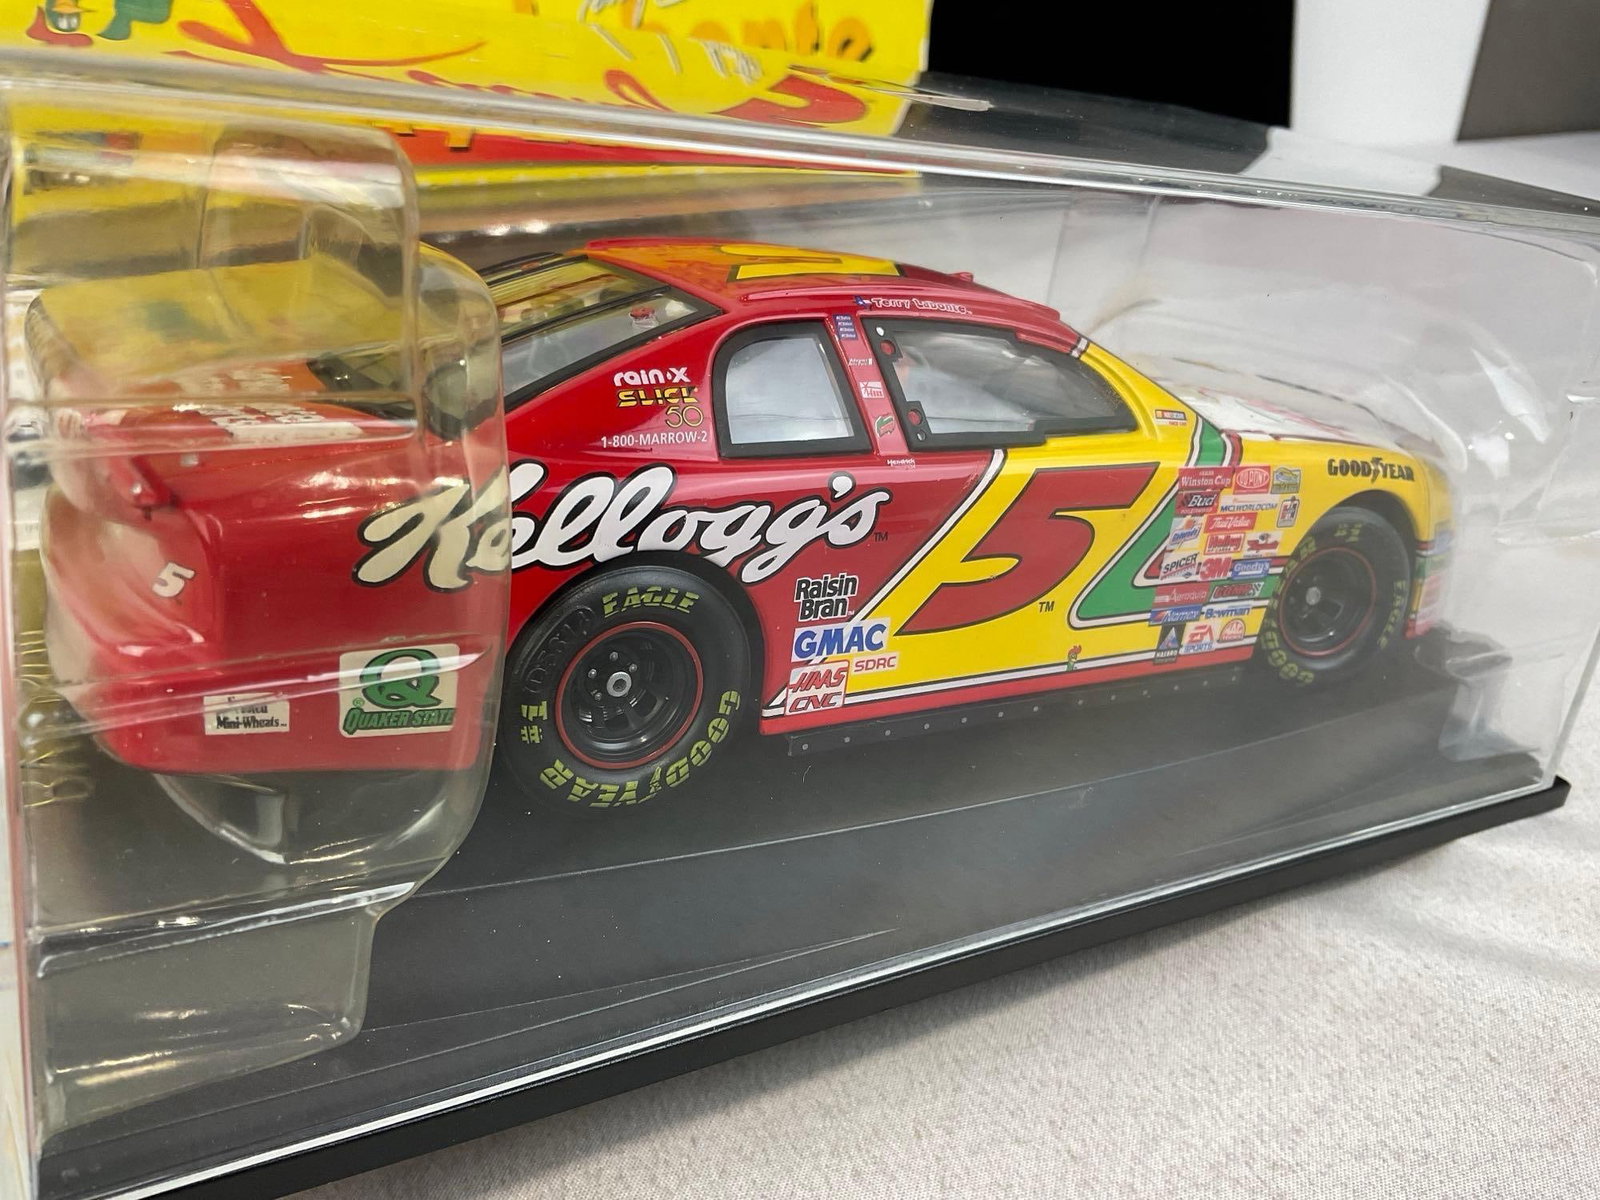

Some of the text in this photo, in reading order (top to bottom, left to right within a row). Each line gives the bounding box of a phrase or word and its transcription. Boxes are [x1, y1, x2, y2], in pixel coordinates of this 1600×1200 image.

[871, 297, 911, 309] Terry
[665, 405, 704, 428] 50
[600, 430, 708, 448] 1-800-MARROW-2
[1187, 493, 1218, 508] Bud
[352, 462, 893, 592] Kellogg's
[892, 461, 1161, 637] 5
[1162, 552, 1198, 574] SPICER
[1199, 557, 1233, 581] 3M
[151, 561, 196, 598] 5
[794, 573, 859, 602] Raisin
[602, 586, 700, 618] EAGLE
[798, 597, 849, 622] Bran
[794, 623, 887, 660] GMAC
[854, 656, 897, 673] SDRC
[788, 691, 842, 713] CNC
